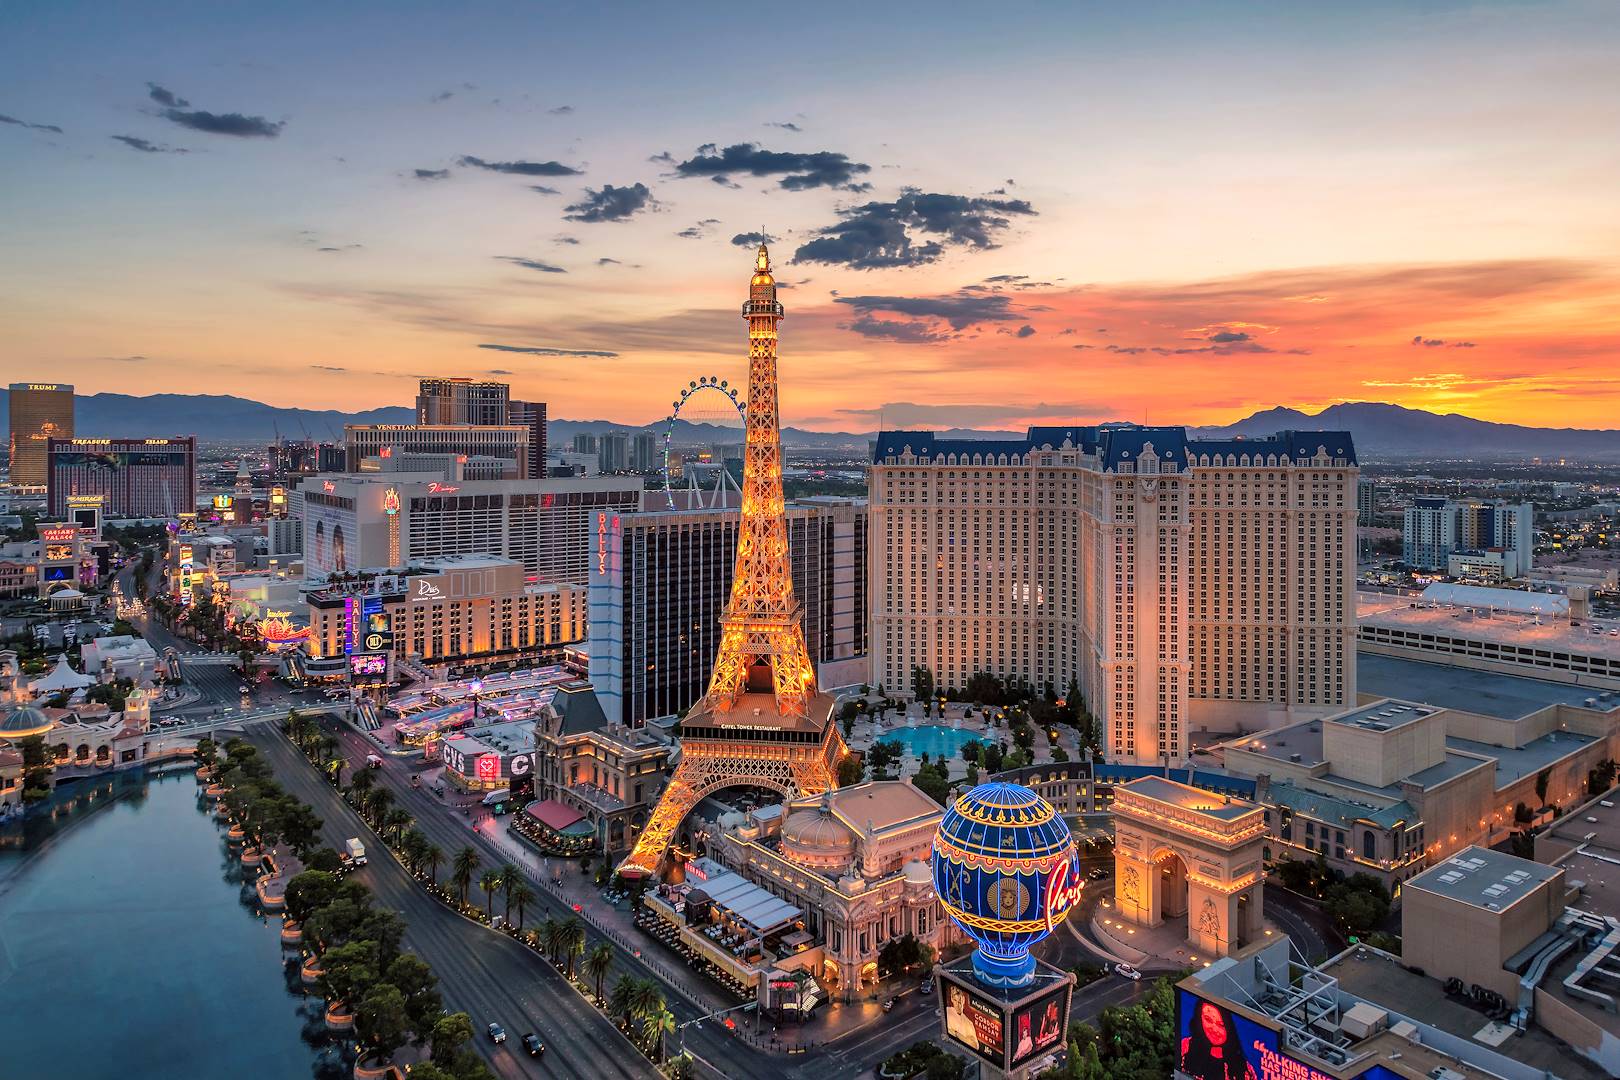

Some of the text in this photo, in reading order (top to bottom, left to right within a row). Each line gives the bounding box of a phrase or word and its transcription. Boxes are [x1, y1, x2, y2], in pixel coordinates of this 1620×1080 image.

[369, 637, 380, 647] BLT
[443, 744, 465, 773] CVS
[1044, 858, 1085, 933] Paris
[1261, 1057, 1281, 1073] HAS
